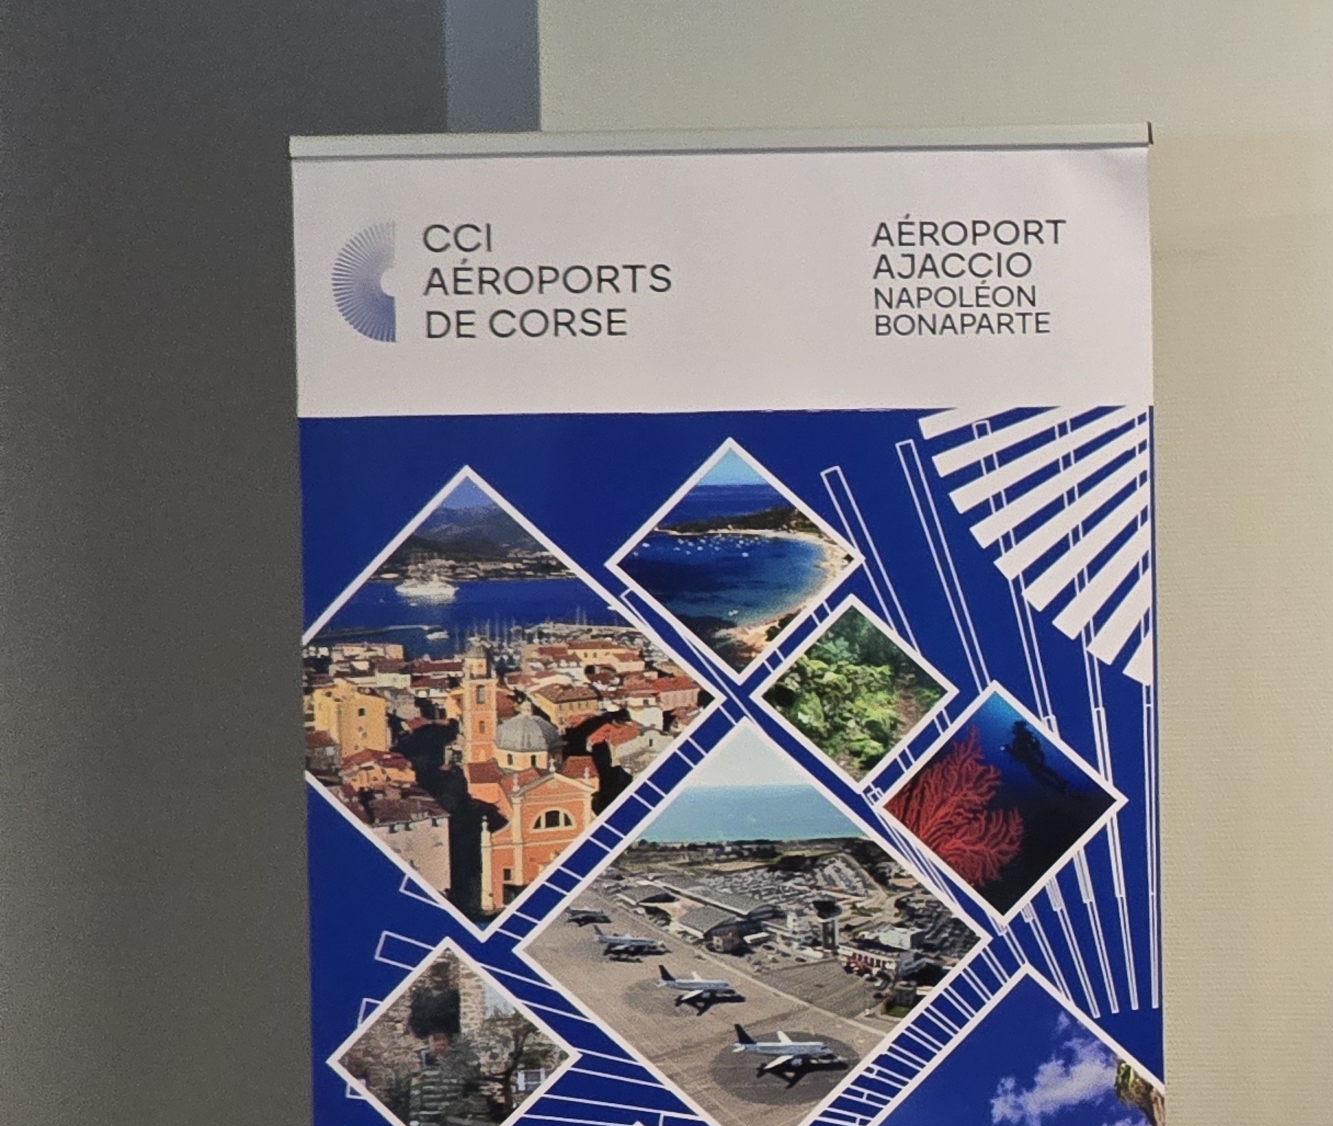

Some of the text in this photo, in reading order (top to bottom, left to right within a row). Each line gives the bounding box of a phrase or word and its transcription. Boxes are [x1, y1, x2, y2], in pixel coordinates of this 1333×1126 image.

[423, 223, 492, 252] CCI
[871, 213, 1066, 247] AÉROPORT
[423, 258, 671, 296] AÉROPORTS
[873, 252, 1032, 279] AJACCIO
[874, 279, 1036, 309] NAPOLÉON
[426, 308, 627, 338] DE CORSE
[875, 312, 1051, 336] BONAPARTE
